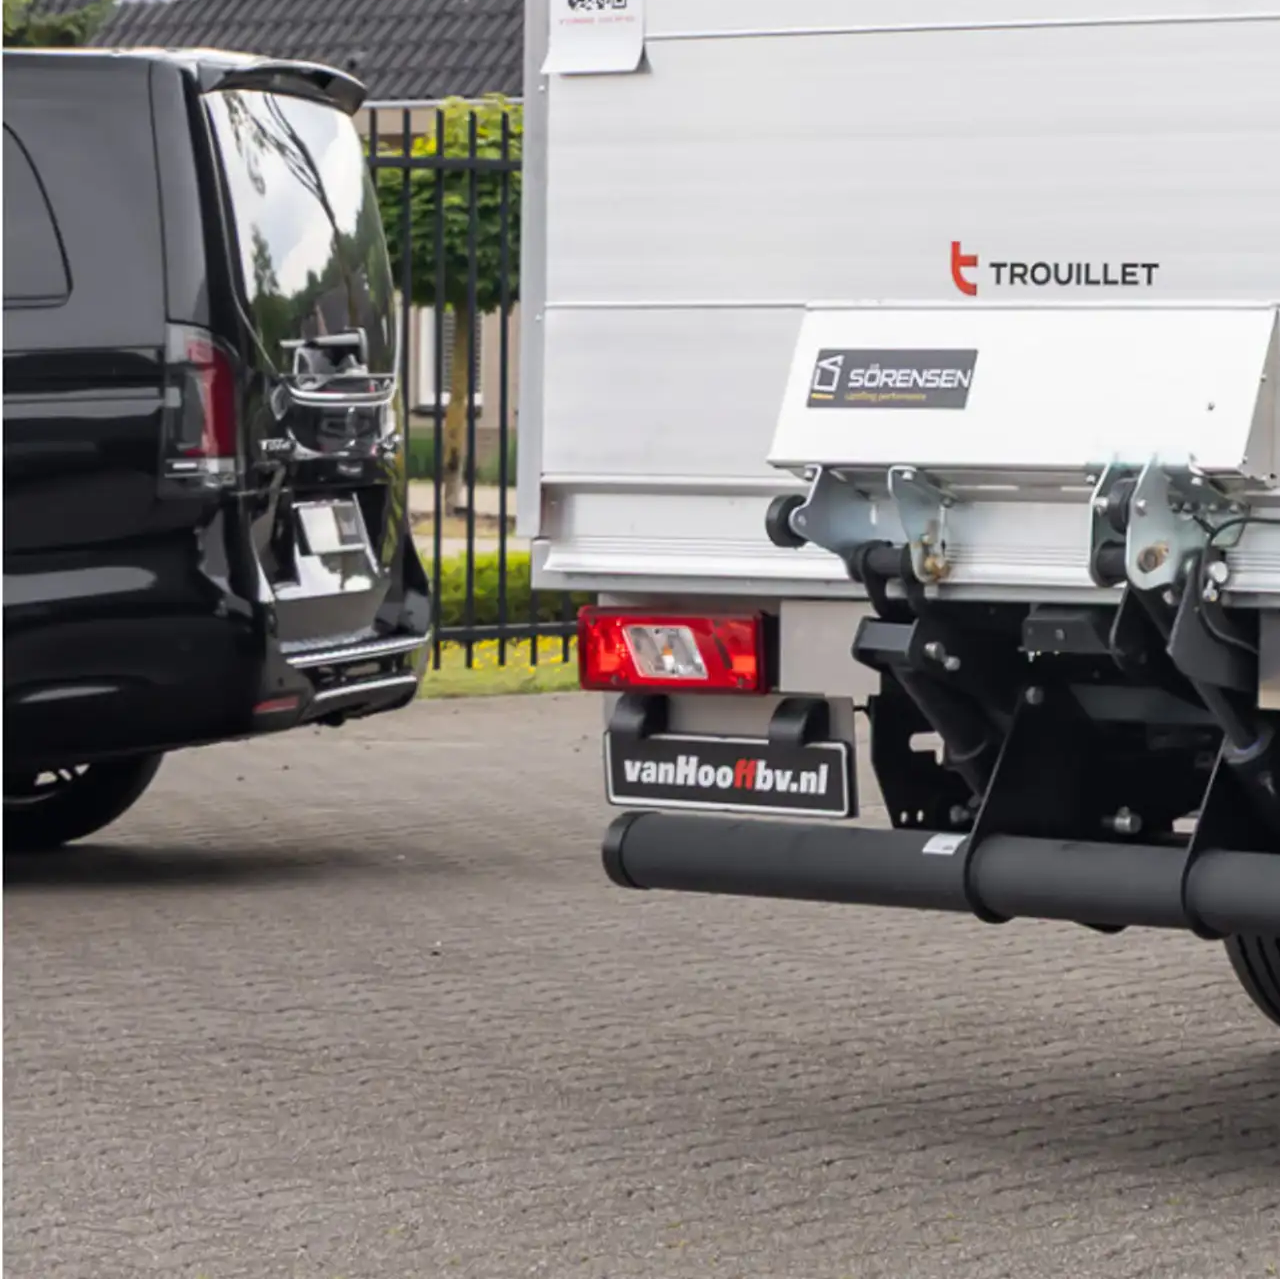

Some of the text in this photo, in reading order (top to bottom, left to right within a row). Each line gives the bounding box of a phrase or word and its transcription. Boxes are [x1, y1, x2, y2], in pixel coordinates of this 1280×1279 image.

[988, 261, 1160, 287] TROUILLET
[847, 362, 972, 389] SÖRENSEN
[623, 754, 829, 796] vanHooffbv.nl
